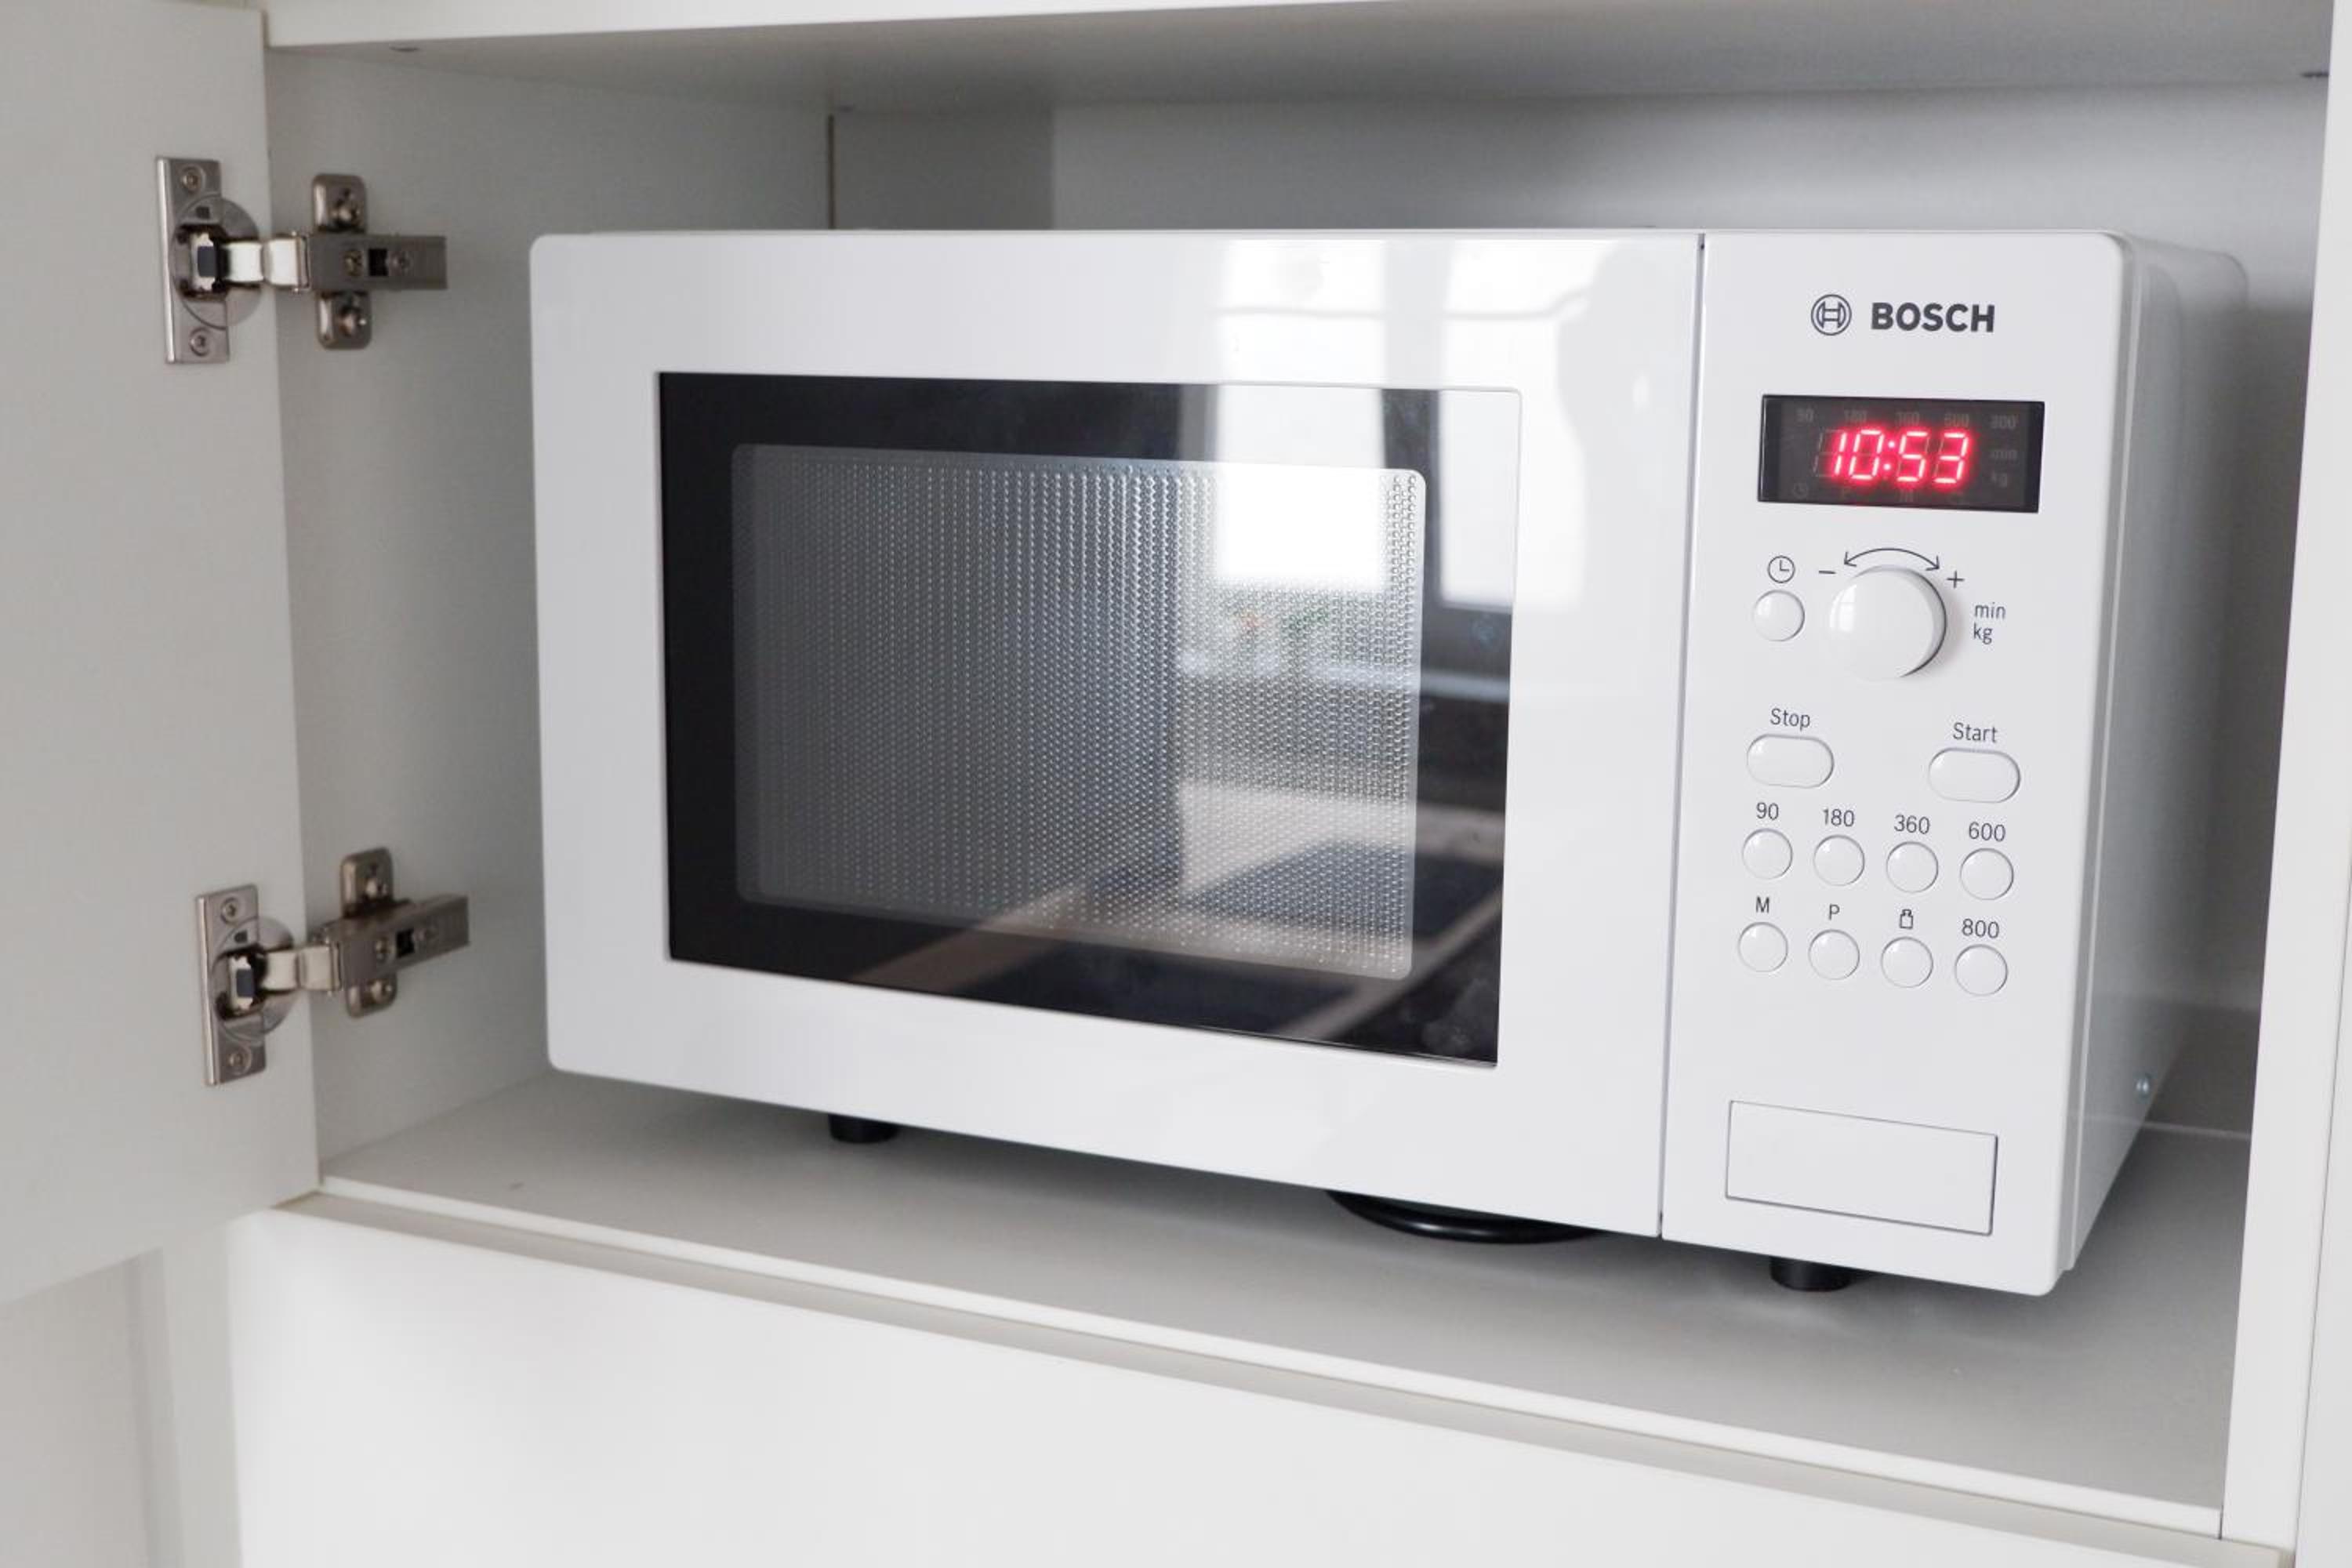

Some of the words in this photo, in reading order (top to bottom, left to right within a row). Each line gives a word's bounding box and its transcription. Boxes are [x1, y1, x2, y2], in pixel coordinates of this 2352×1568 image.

[1871, 302, 1995, 333] BOSCH
[1833, 428, 1971, 485] 10:53
[1973, 601, 2007, 620] min
[1973, 622, 1993, 645] kg
[1769, 707, 1811, 732] Stop
[1952, 721, 1998, 744] Start
[1755, 801, 1780, 821] 90
[1823, 808, 1856, 828] 180
[1893, 814, 1931, 835] 360
[1968, 821, 2006, 843] 600
[1755, 895, 1770, 914] M
[1828, 903, 1841, 921] P
[1961, 917, 2000, 939] 800
